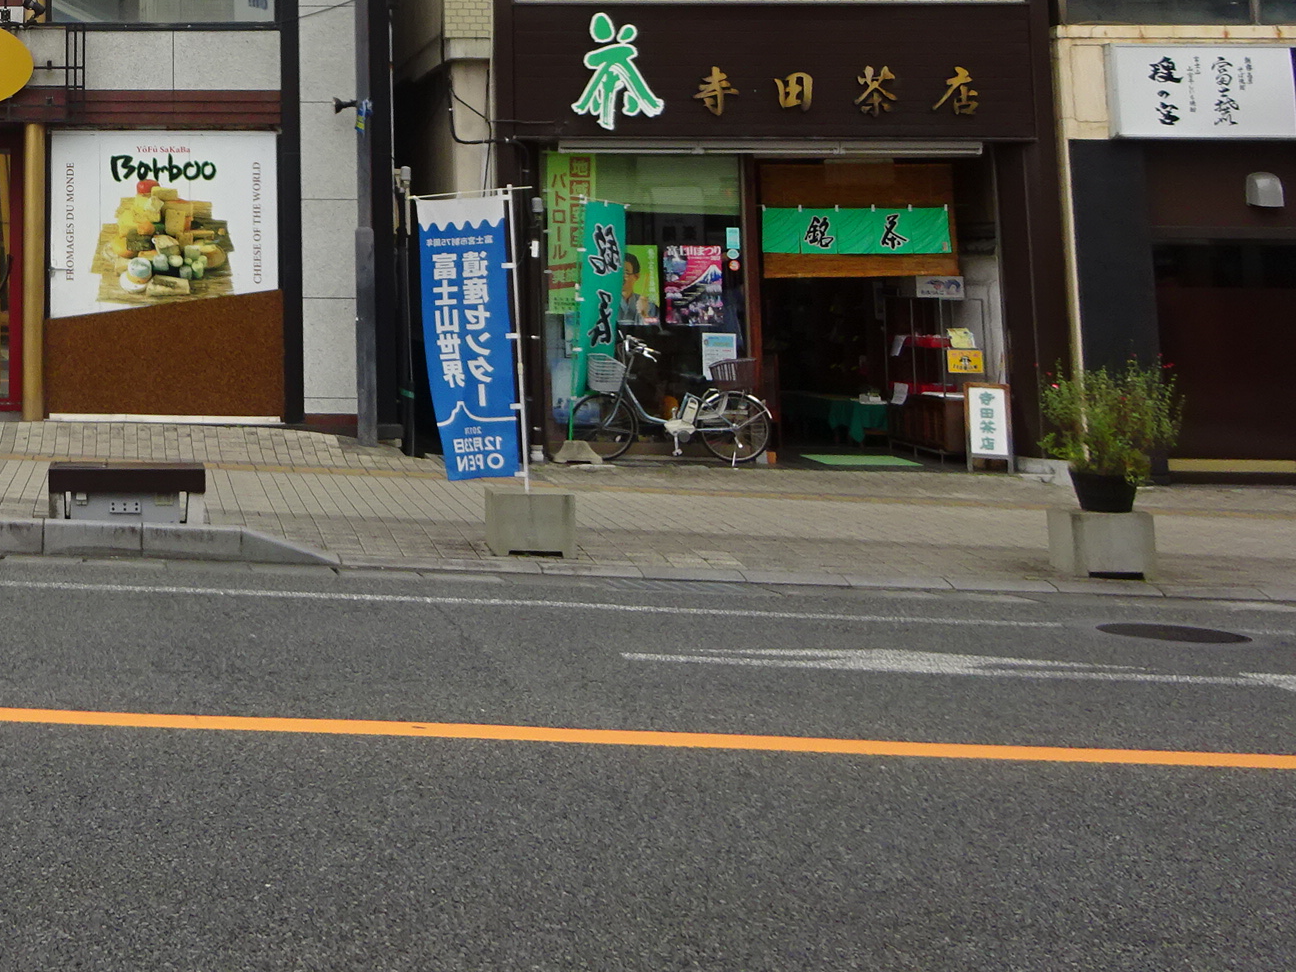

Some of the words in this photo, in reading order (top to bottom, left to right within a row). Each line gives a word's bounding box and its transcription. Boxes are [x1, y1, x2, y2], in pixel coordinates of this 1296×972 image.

[693, 66, 981, 117] 寺田茶店
[159, 145, 191, 153] SaKaBa
[66, 162, 75, 202] MONDE
[252, 161, 261, 202] WORLD
[66, 204, 75, 221] DU
[252, 203, 262, 226] THE
[551, 172, 568, 260] パトロール
[804, 214, 909, 249] 銘茶
[66, 222, 75, 281] FROMAGES
[252, 227, 262, 242] OF
[252, 243, 262, 284] CHEESE
[978, 391, 997, 451] 寺田茶店
